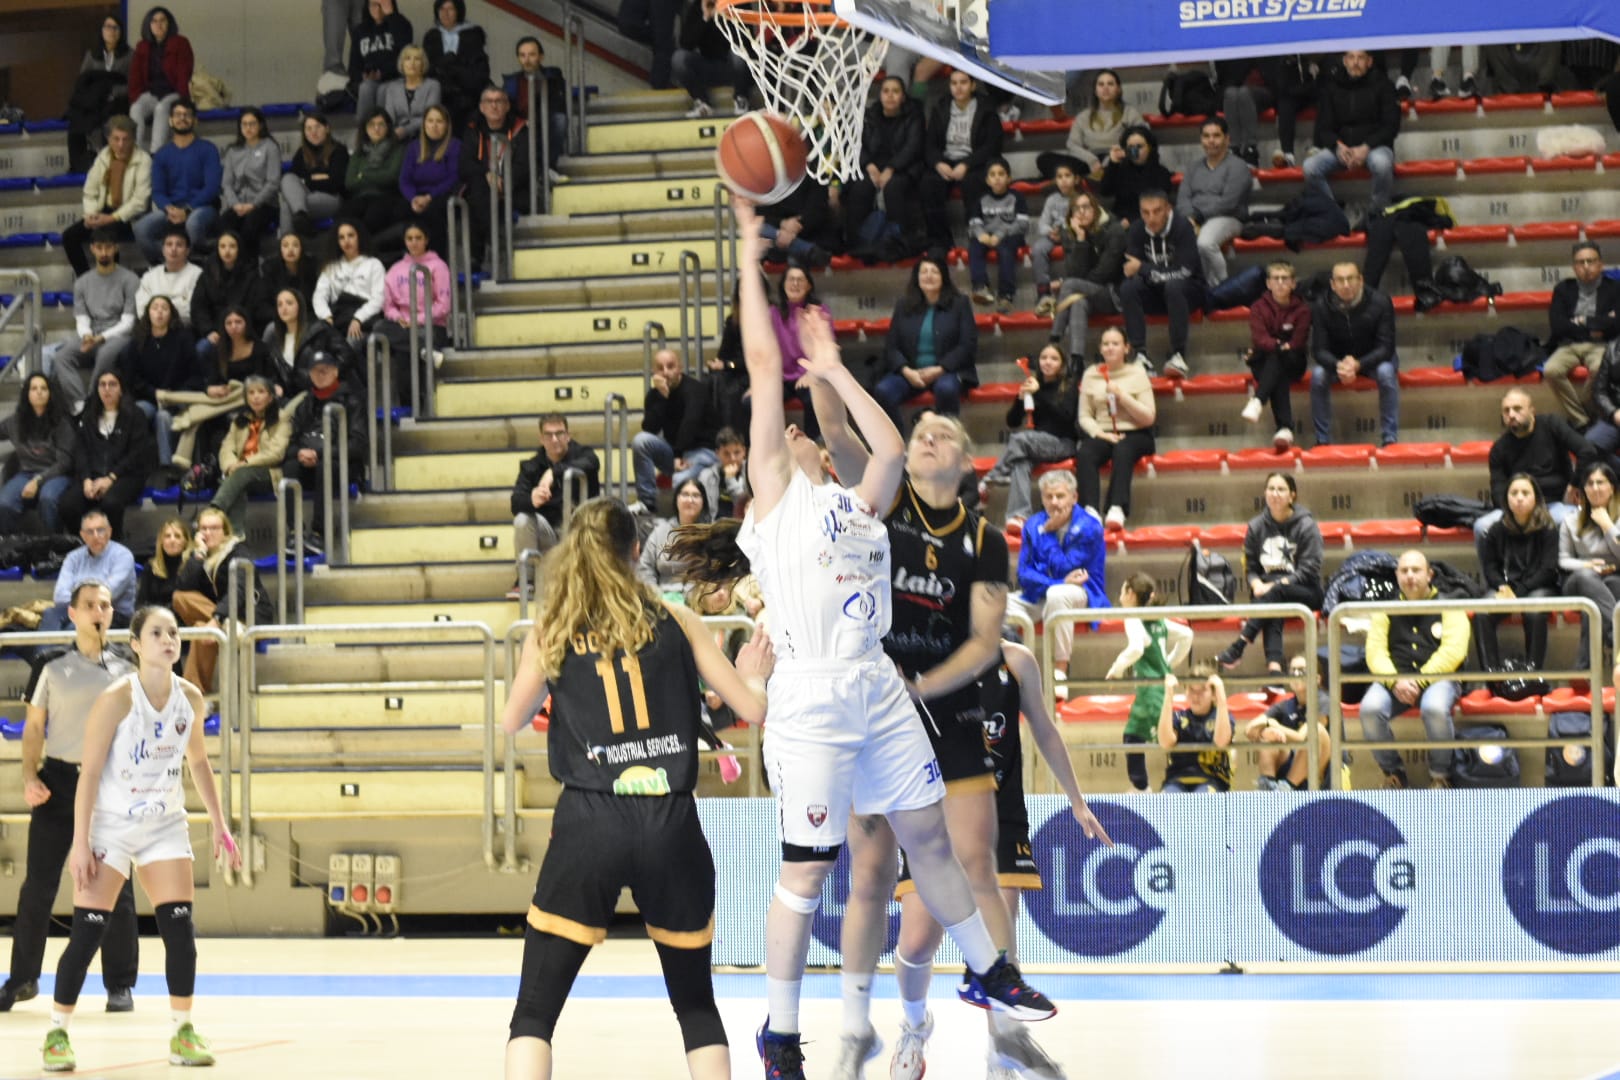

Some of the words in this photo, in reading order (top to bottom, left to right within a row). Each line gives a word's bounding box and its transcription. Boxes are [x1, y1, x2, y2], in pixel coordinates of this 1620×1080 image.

[691, 187, 701, 200] 8
[656, 251, 665, 265] 7
[618, 317, 628, 331] 6
[580, 386, 590, 400] 5
[925, 544, 939, 571] 6
[595, 655, 650, 734] 11
[154, 721, 164, 739] 2
[606, 740, 647, 765] INDUSTRIAL
[648, 734, 681, 758] SERVICES
[1089, 751, 1117, 768] 1042
